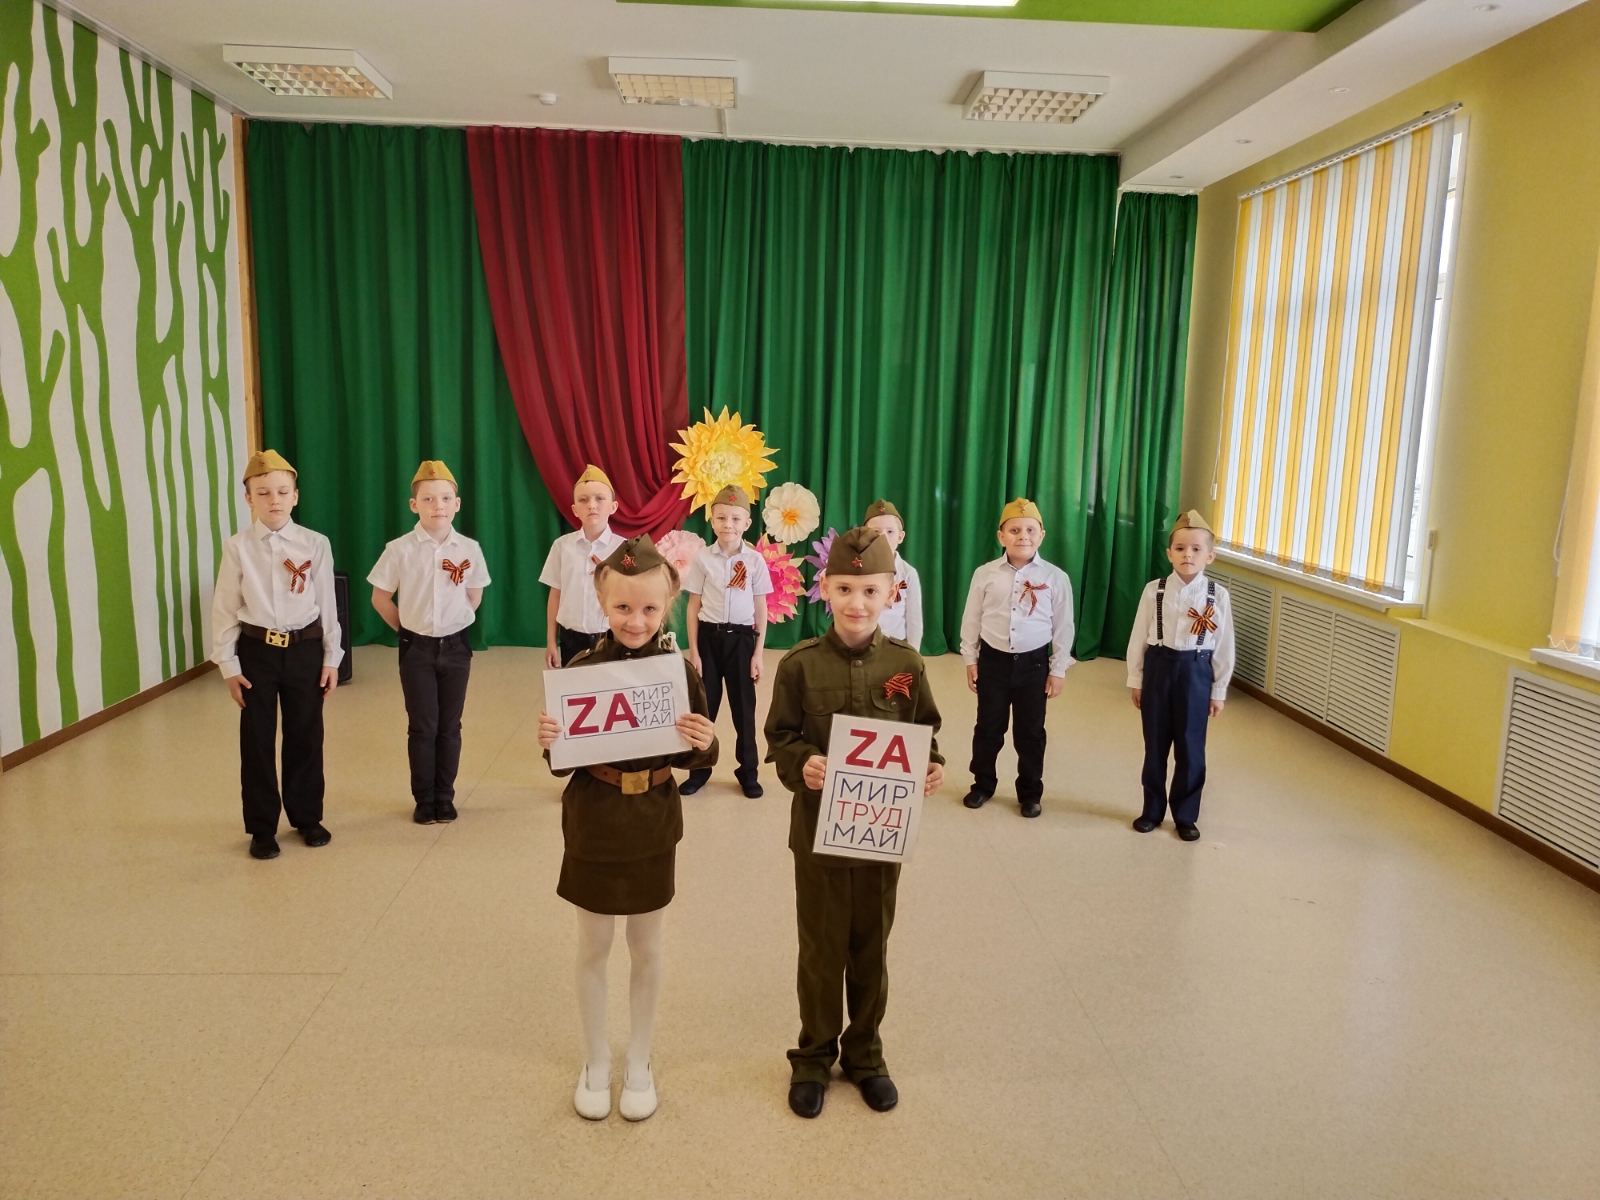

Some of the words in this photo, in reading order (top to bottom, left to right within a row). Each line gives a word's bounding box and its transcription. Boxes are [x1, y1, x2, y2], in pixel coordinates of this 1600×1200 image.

[632, 685, 671, 702] МИР
[632, 698, 671, 714] ТРУД
[567, 692, 640, 736] ZA
[634, 711, 671, 727] МАЙ
[845, 728, 911, 774] ZA
[840, 778, 909, 805] МИР
[837, 800, 902, 829] ТРУД
[832, 822, 899, 850] МАЙ
